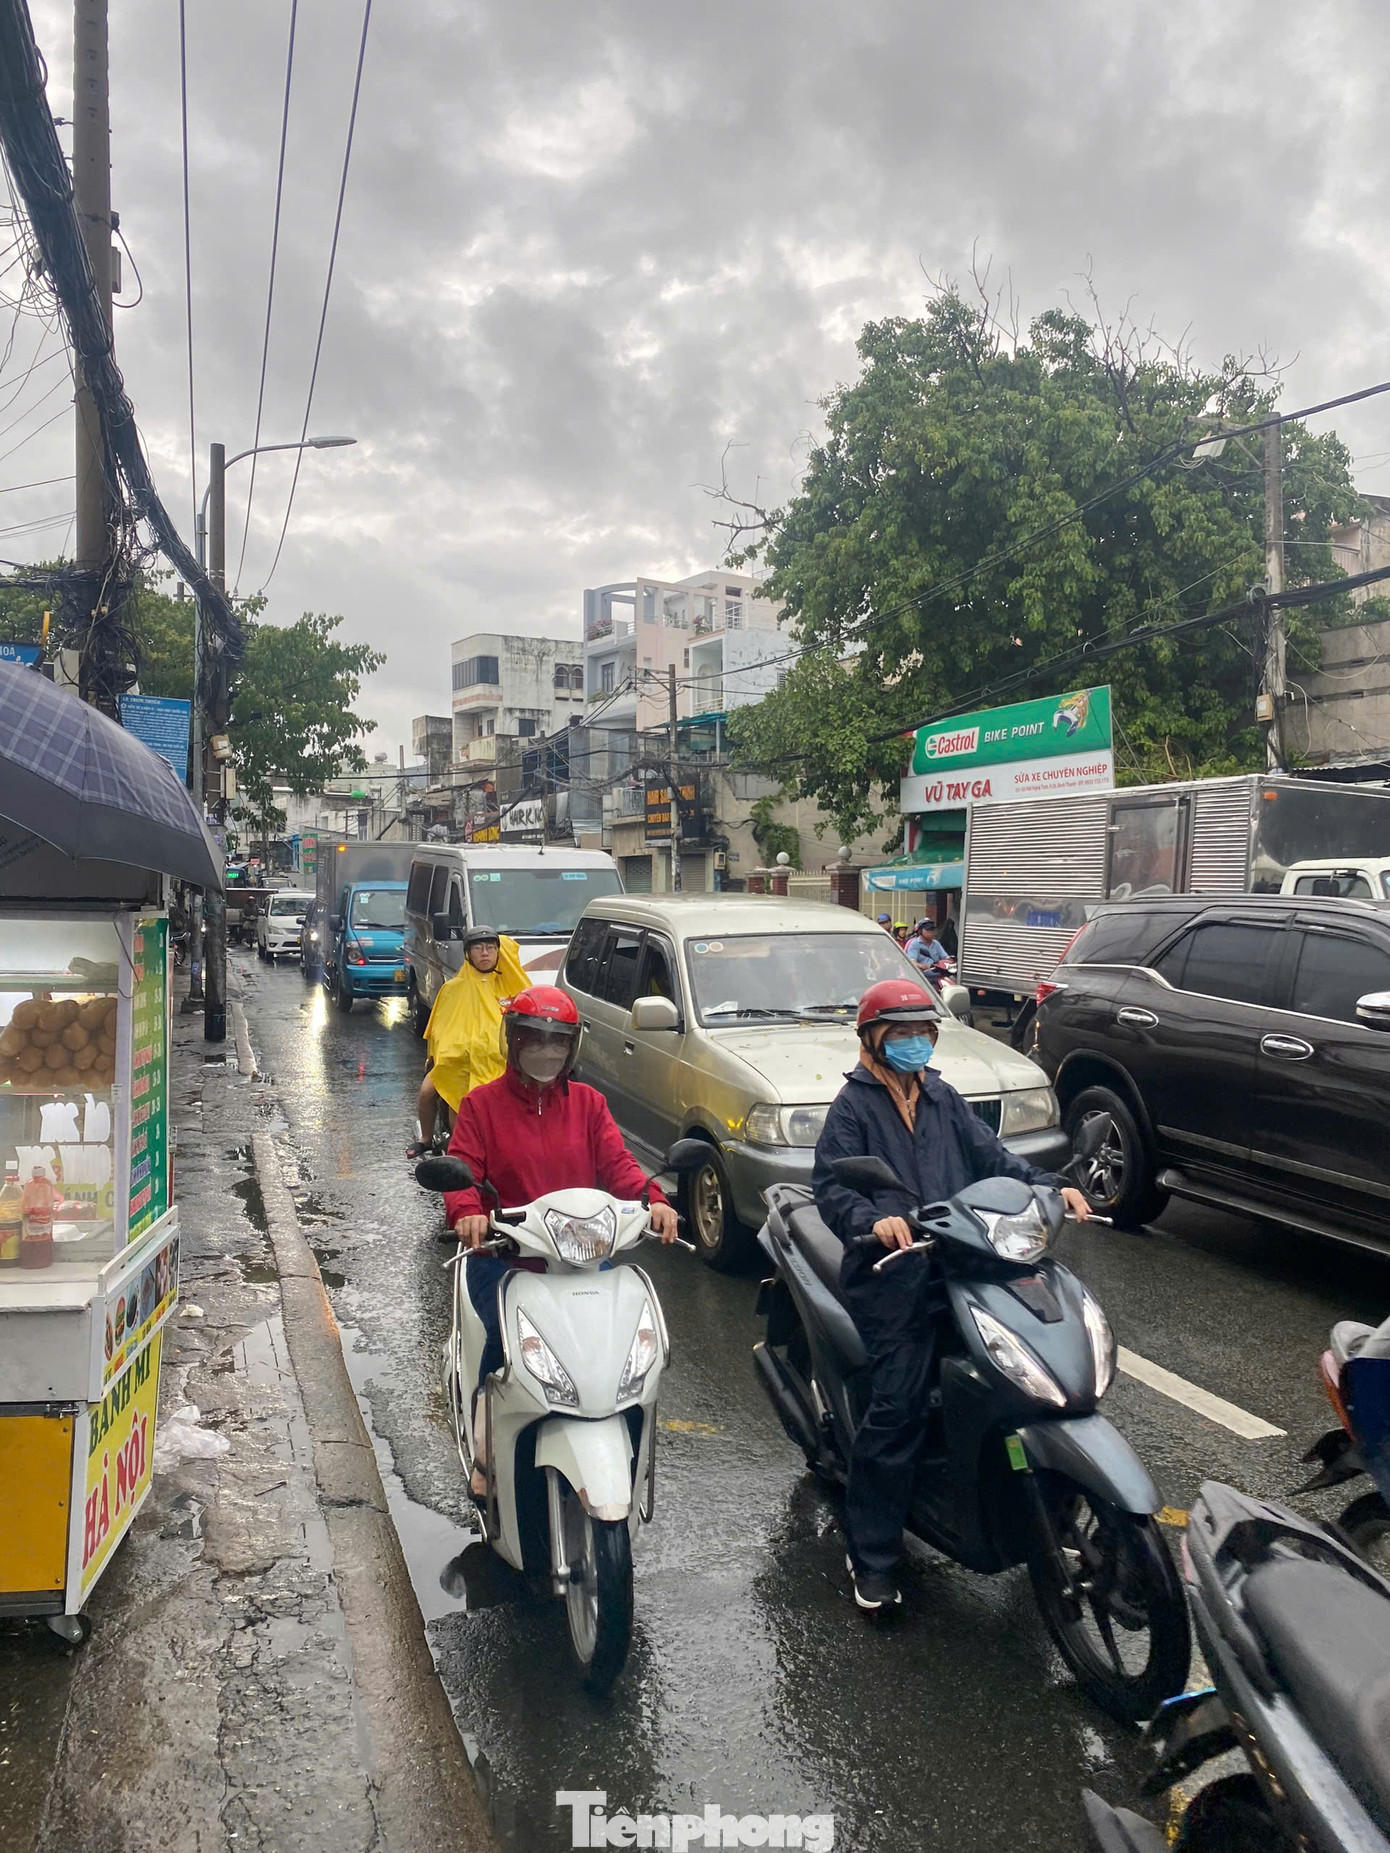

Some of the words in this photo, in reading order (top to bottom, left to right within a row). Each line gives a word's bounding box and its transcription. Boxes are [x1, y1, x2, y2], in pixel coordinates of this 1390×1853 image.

[937, 731, 975, 755] Castrol
[984, 728, 1008, 743] BIKE
[1011, 722, 1045, 738] POINT
[1014, 771, 1030, 784] SỬA
[1032, 772, 1041, 781] XE
[1042, 767, 1075, 780] CHUYÊN
[1076, 763, 1108, 777] NGHIỆP
[946, 782, 970, 801] TAY
[971, 779, 993, 799] GA
[115, 1410, 147, 1516] NỘI
